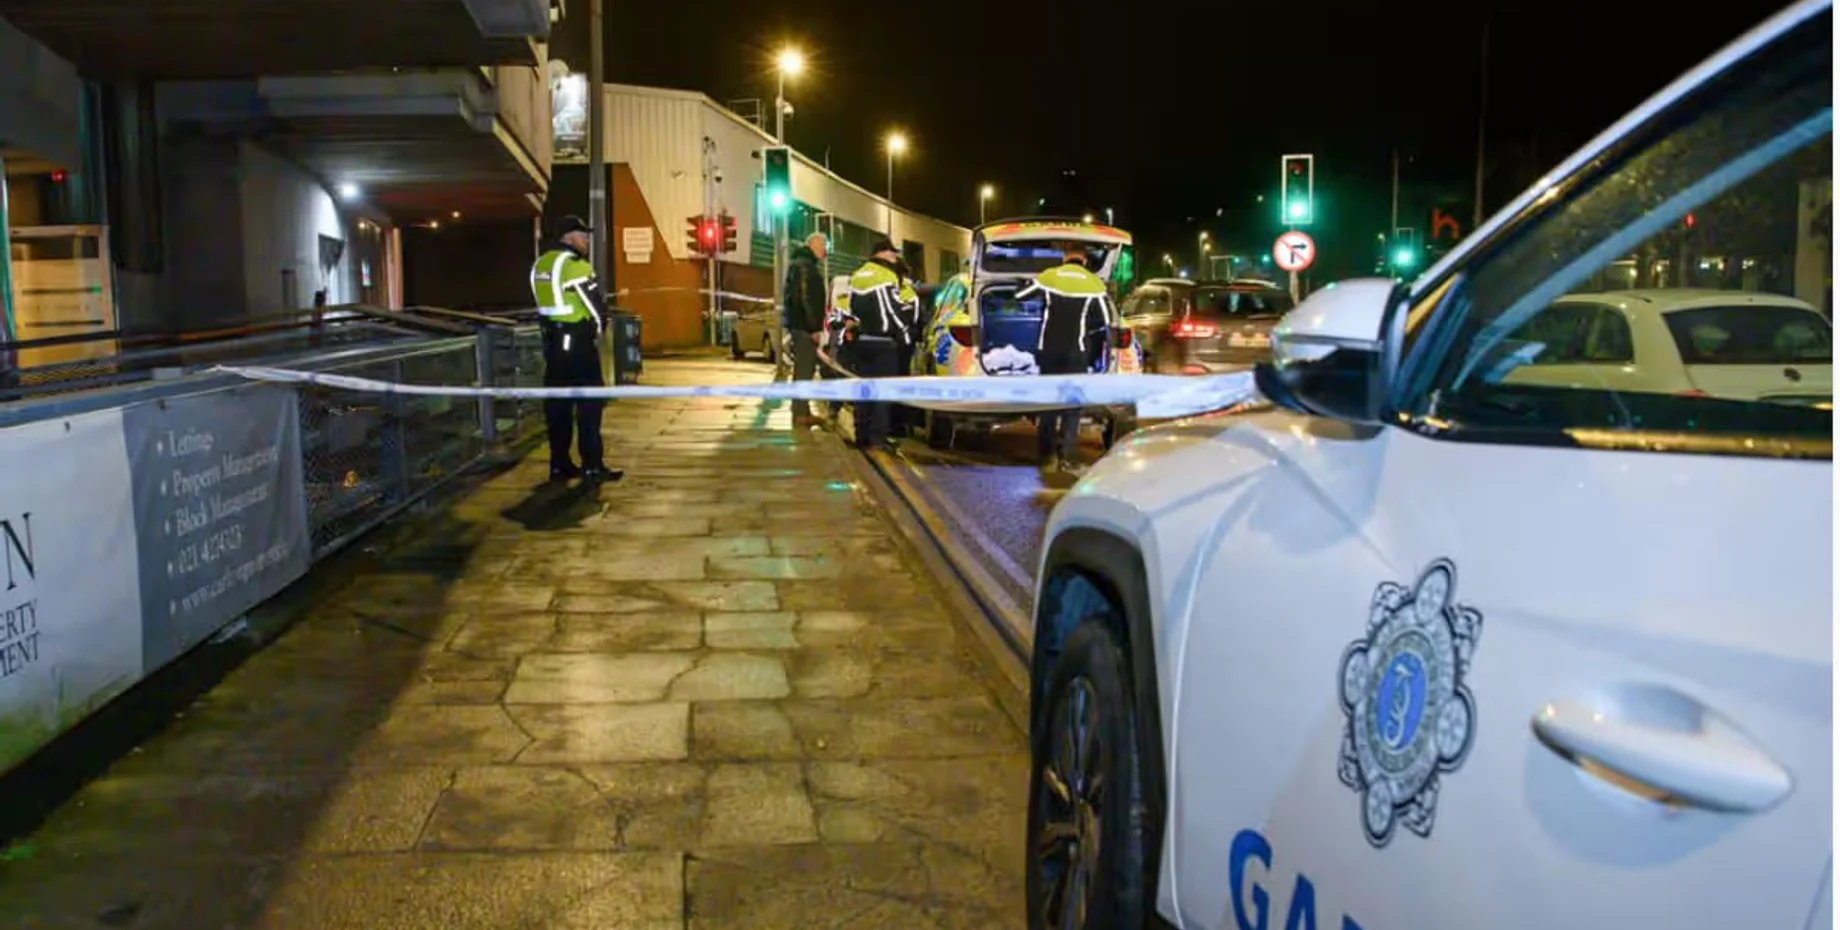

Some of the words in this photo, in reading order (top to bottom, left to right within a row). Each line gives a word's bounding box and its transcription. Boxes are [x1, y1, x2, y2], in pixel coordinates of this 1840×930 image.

[1432, 208, 1460, 240] h
[176, 501, 208, 537] Block
[1229, 829, 1364, 930] GA
